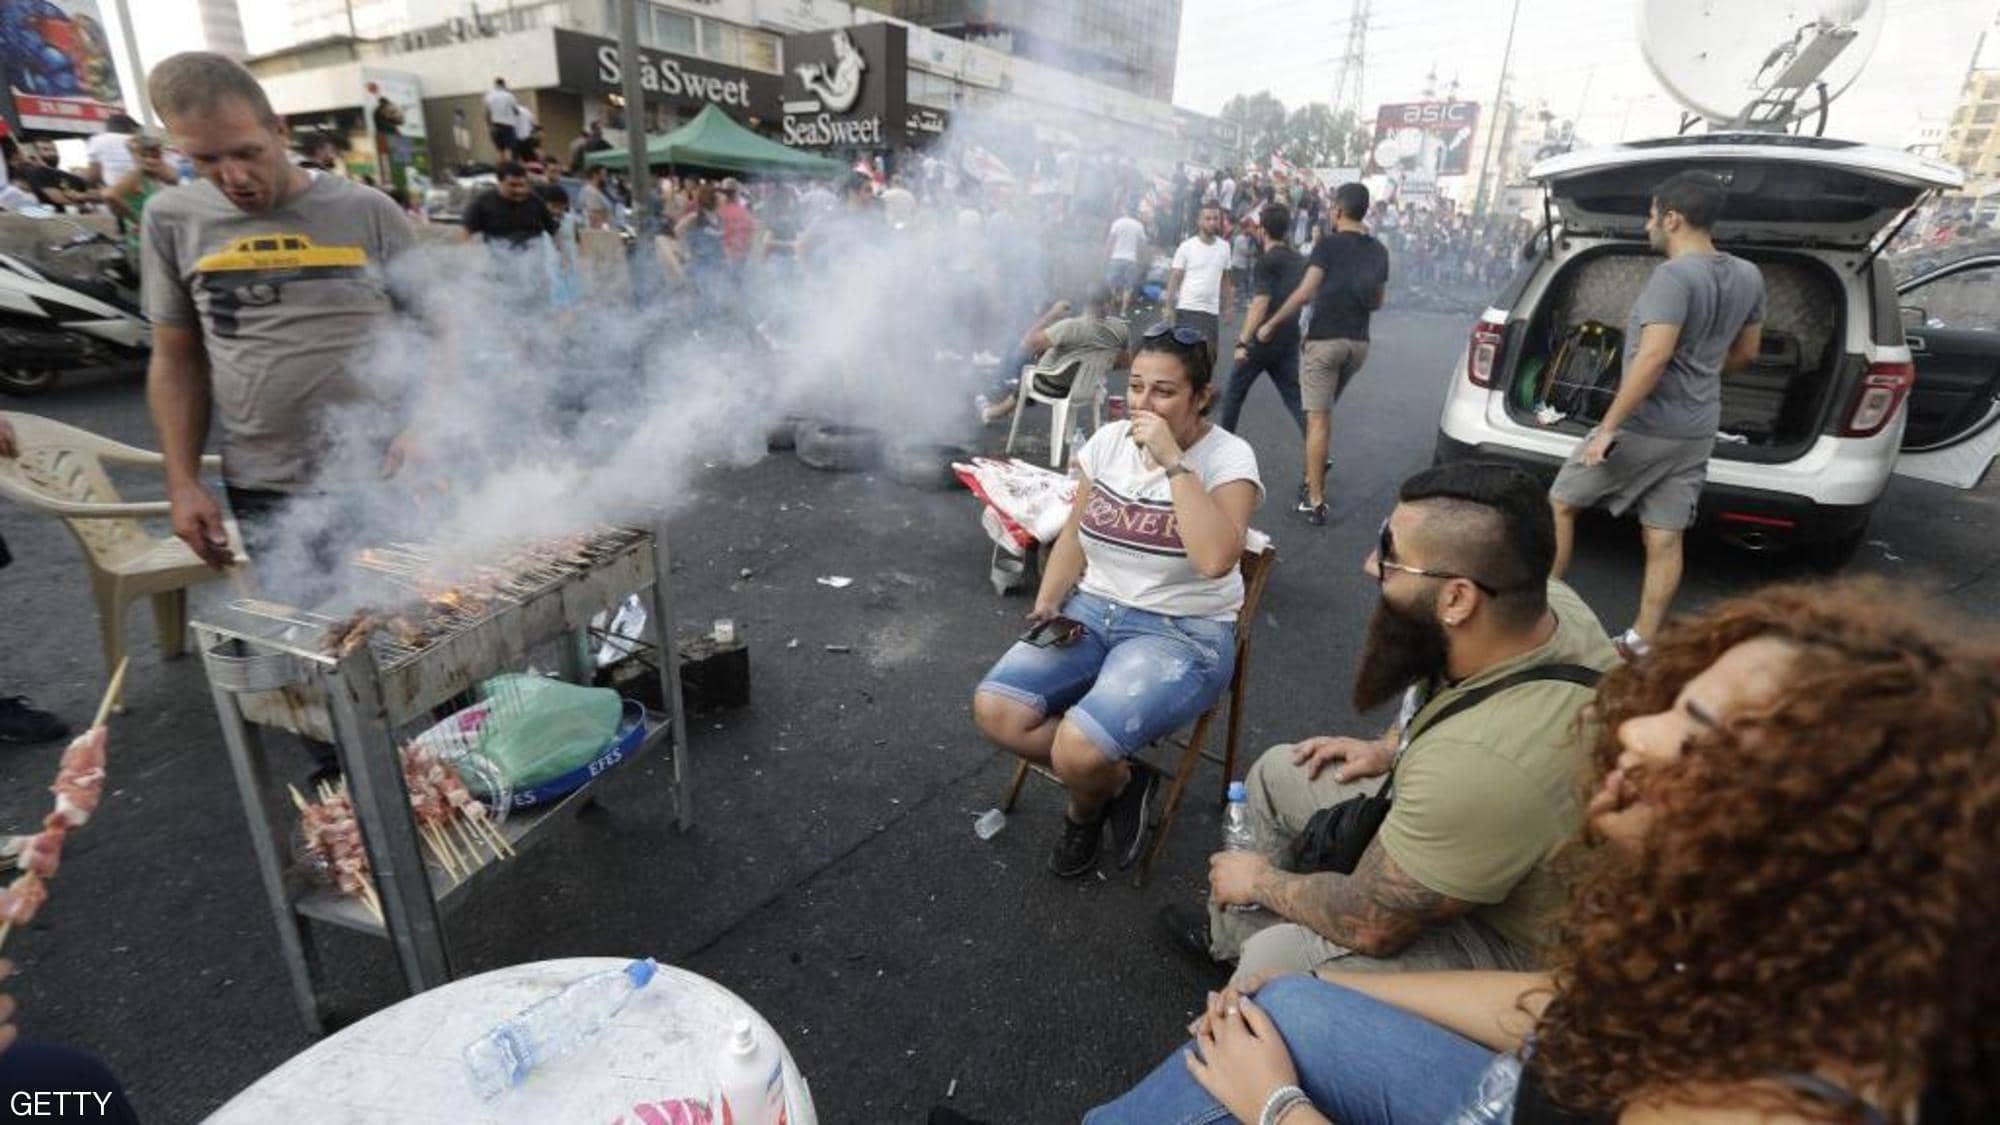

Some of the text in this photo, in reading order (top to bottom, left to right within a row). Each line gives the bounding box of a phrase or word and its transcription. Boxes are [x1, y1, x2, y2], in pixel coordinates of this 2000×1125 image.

[598, 46, 750, 107] SaSweet
[1404, 103, 1466, 123] asic
[783, 113, 881, 145] SeaSweet
[588, 747, 622, 776] EFES
